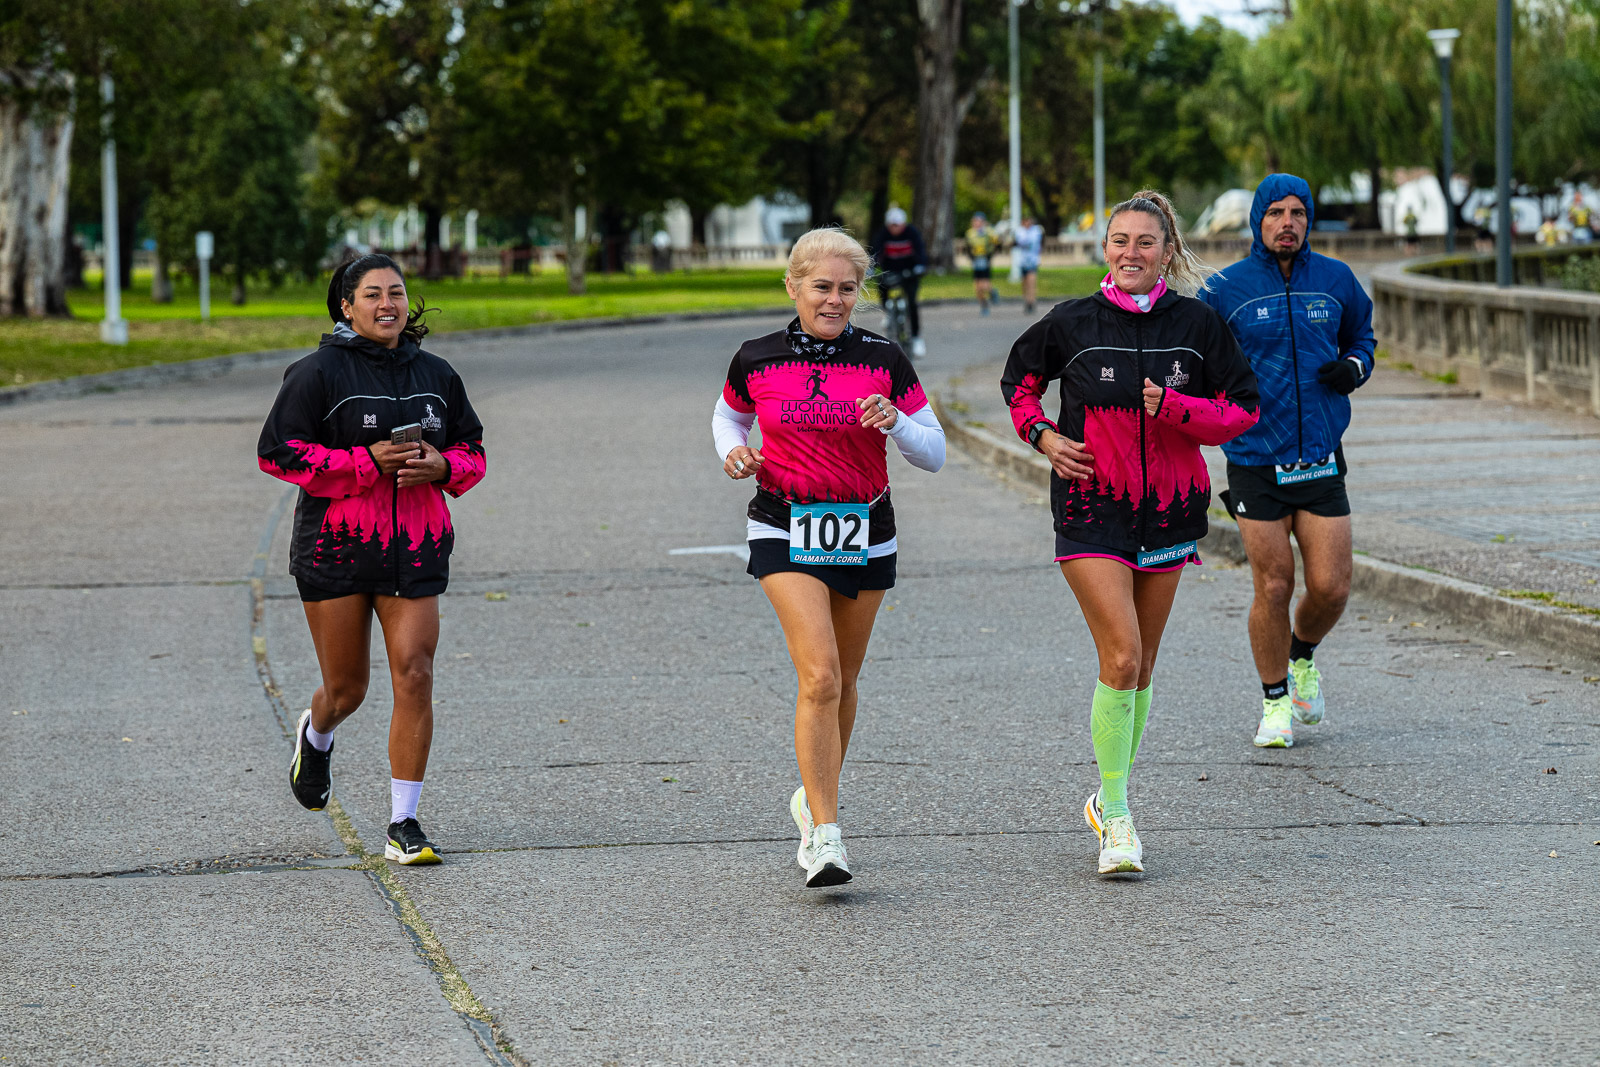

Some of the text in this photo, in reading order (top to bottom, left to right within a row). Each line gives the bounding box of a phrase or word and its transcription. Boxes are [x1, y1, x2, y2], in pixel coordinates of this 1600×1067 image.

[781, 401, 856, 413] WOMAN
[780, 413, 857, 425] RUNNING
[1281, 467, 1334, 484] DIAMANTE CORRE
[796, 512, 862, 553] 102
[794, 554, 836, 563] DIAMANTE
[1141, 550, 1177, 565] DIAMANTE
[1177, 544, 1195, 557] CORRE
